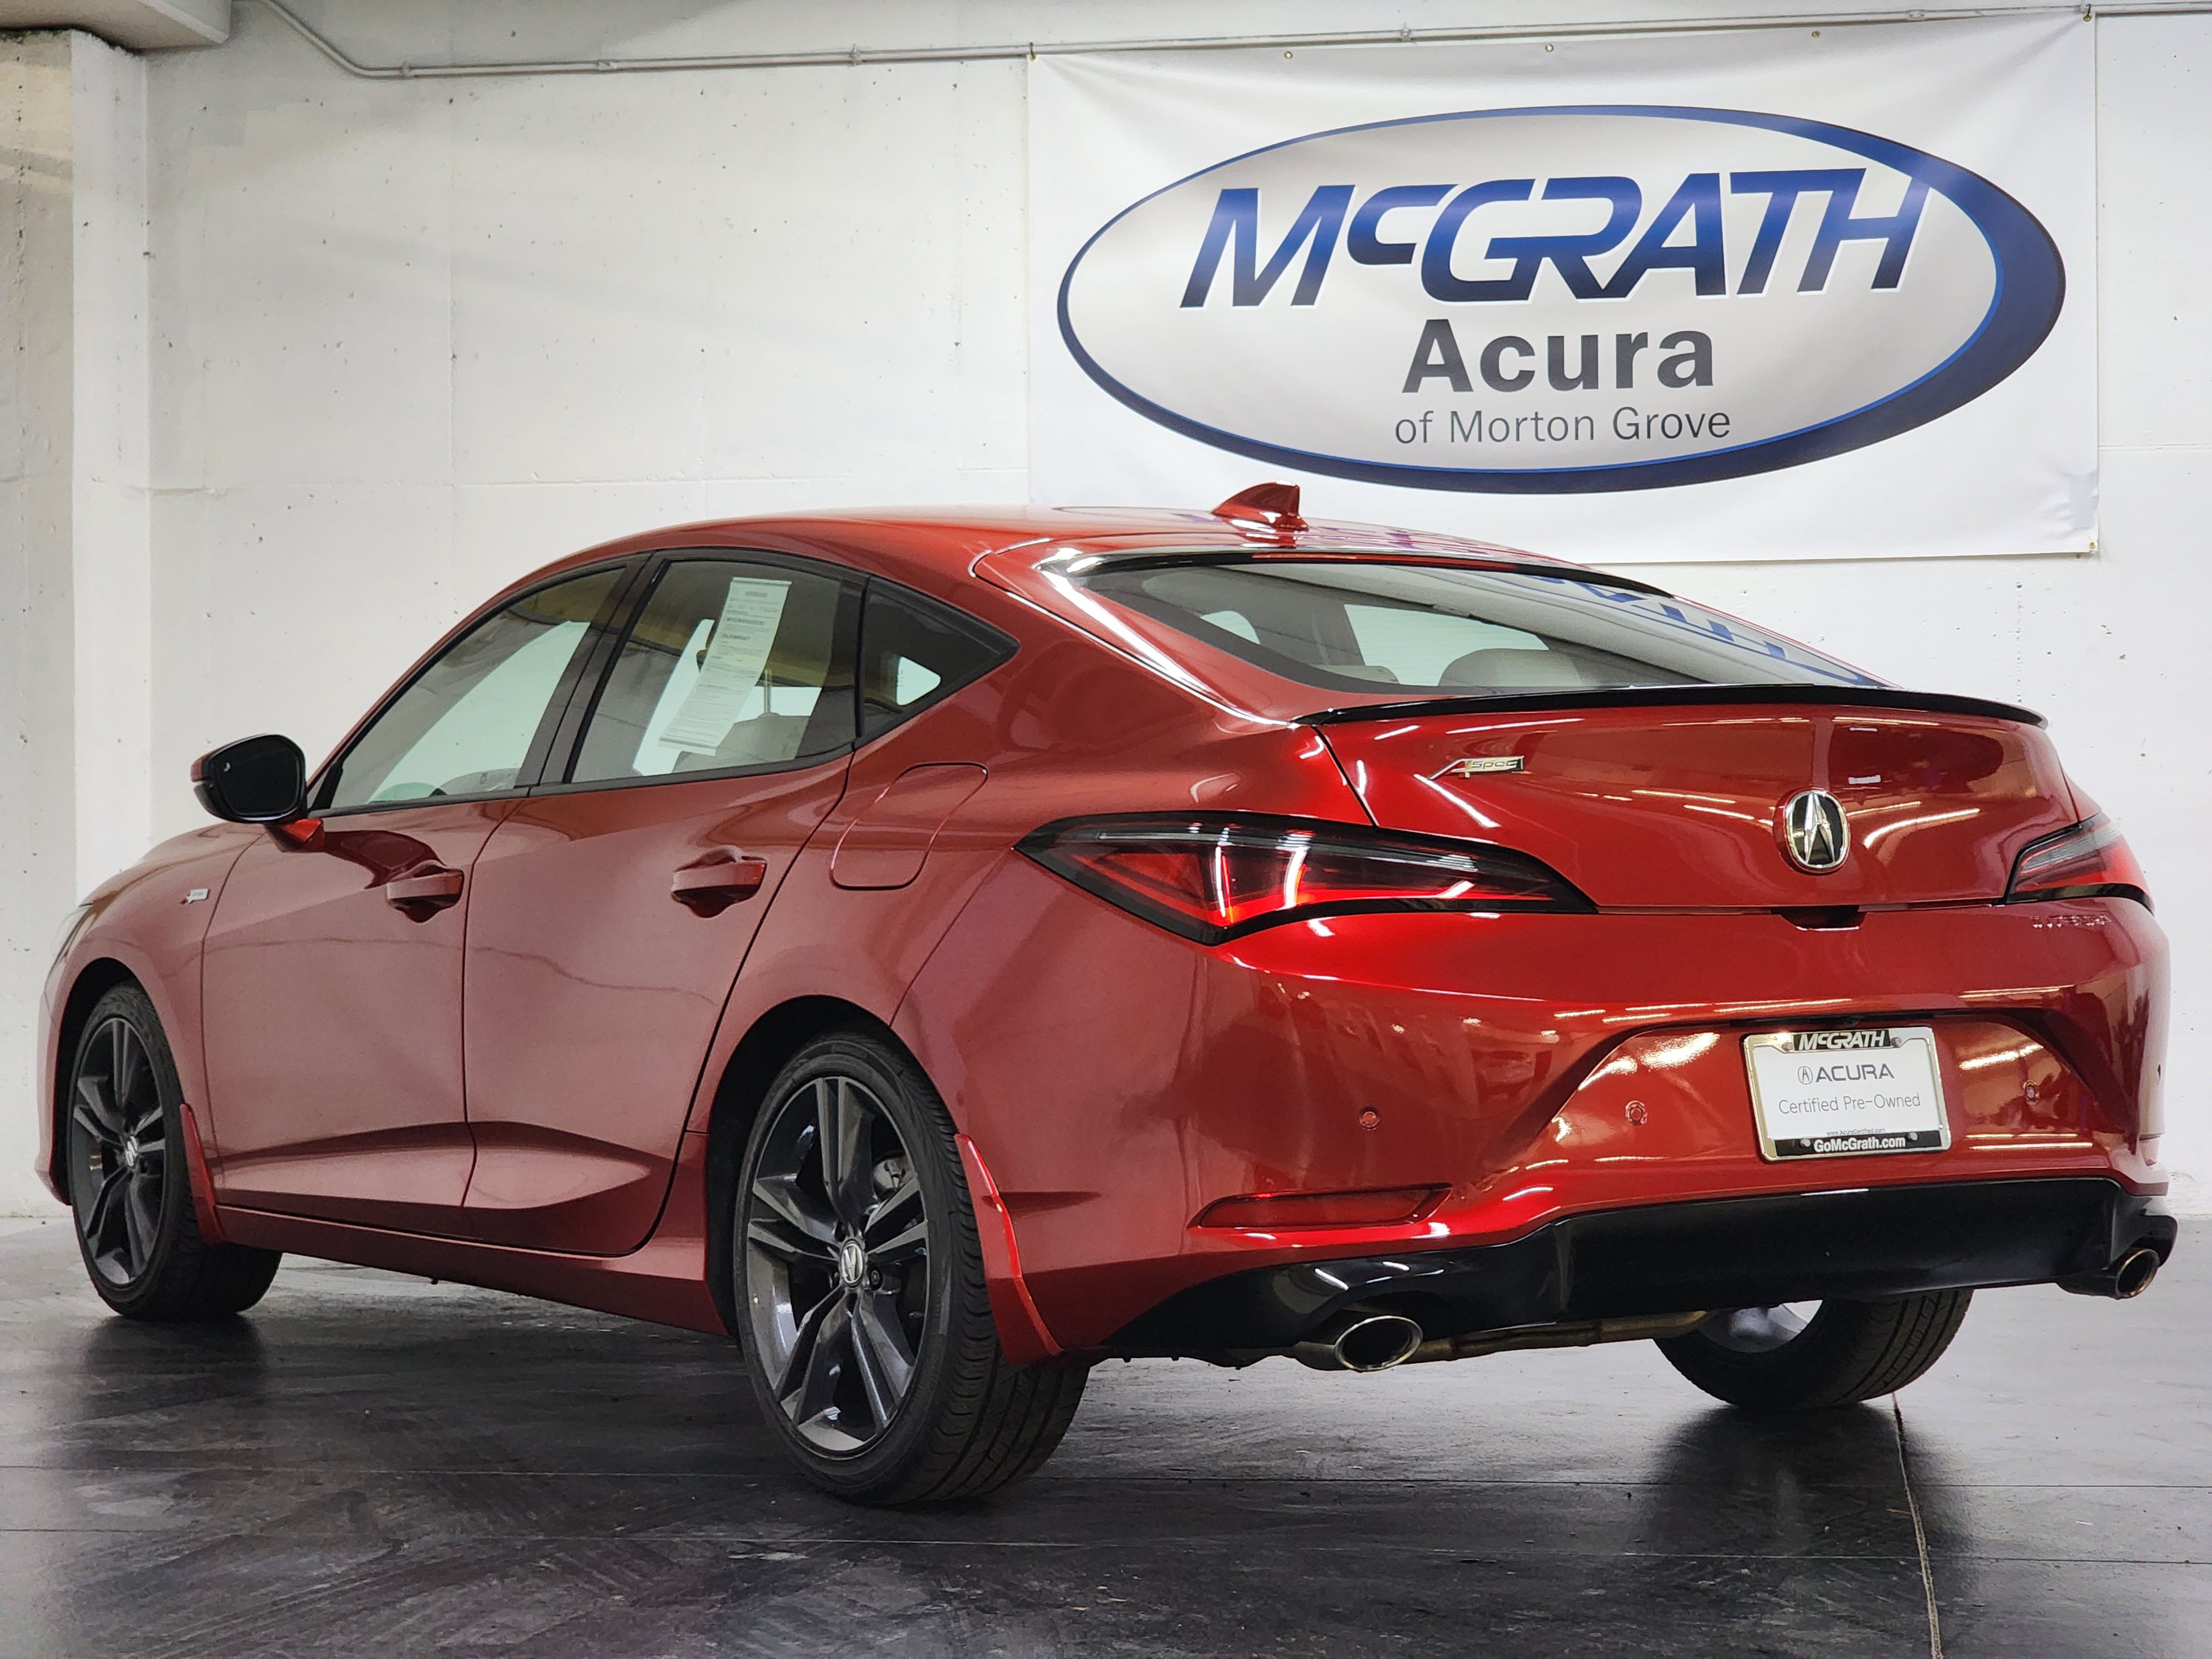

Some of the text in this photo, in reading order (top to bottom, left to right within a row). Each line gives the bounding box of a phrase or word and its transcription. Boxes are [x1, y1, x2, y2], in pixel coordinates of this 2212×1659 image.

[1402, 319, 1714, 393] Acura
[1394, 405, 1731, 444] of Morton Grove
[1815, 1063, 1895, 1083] ACURA
[1778, 1092, 1921, 1114] Certified Pre-Owned
[1813, 1135, 1906, 1152] GoMcGrath.com
